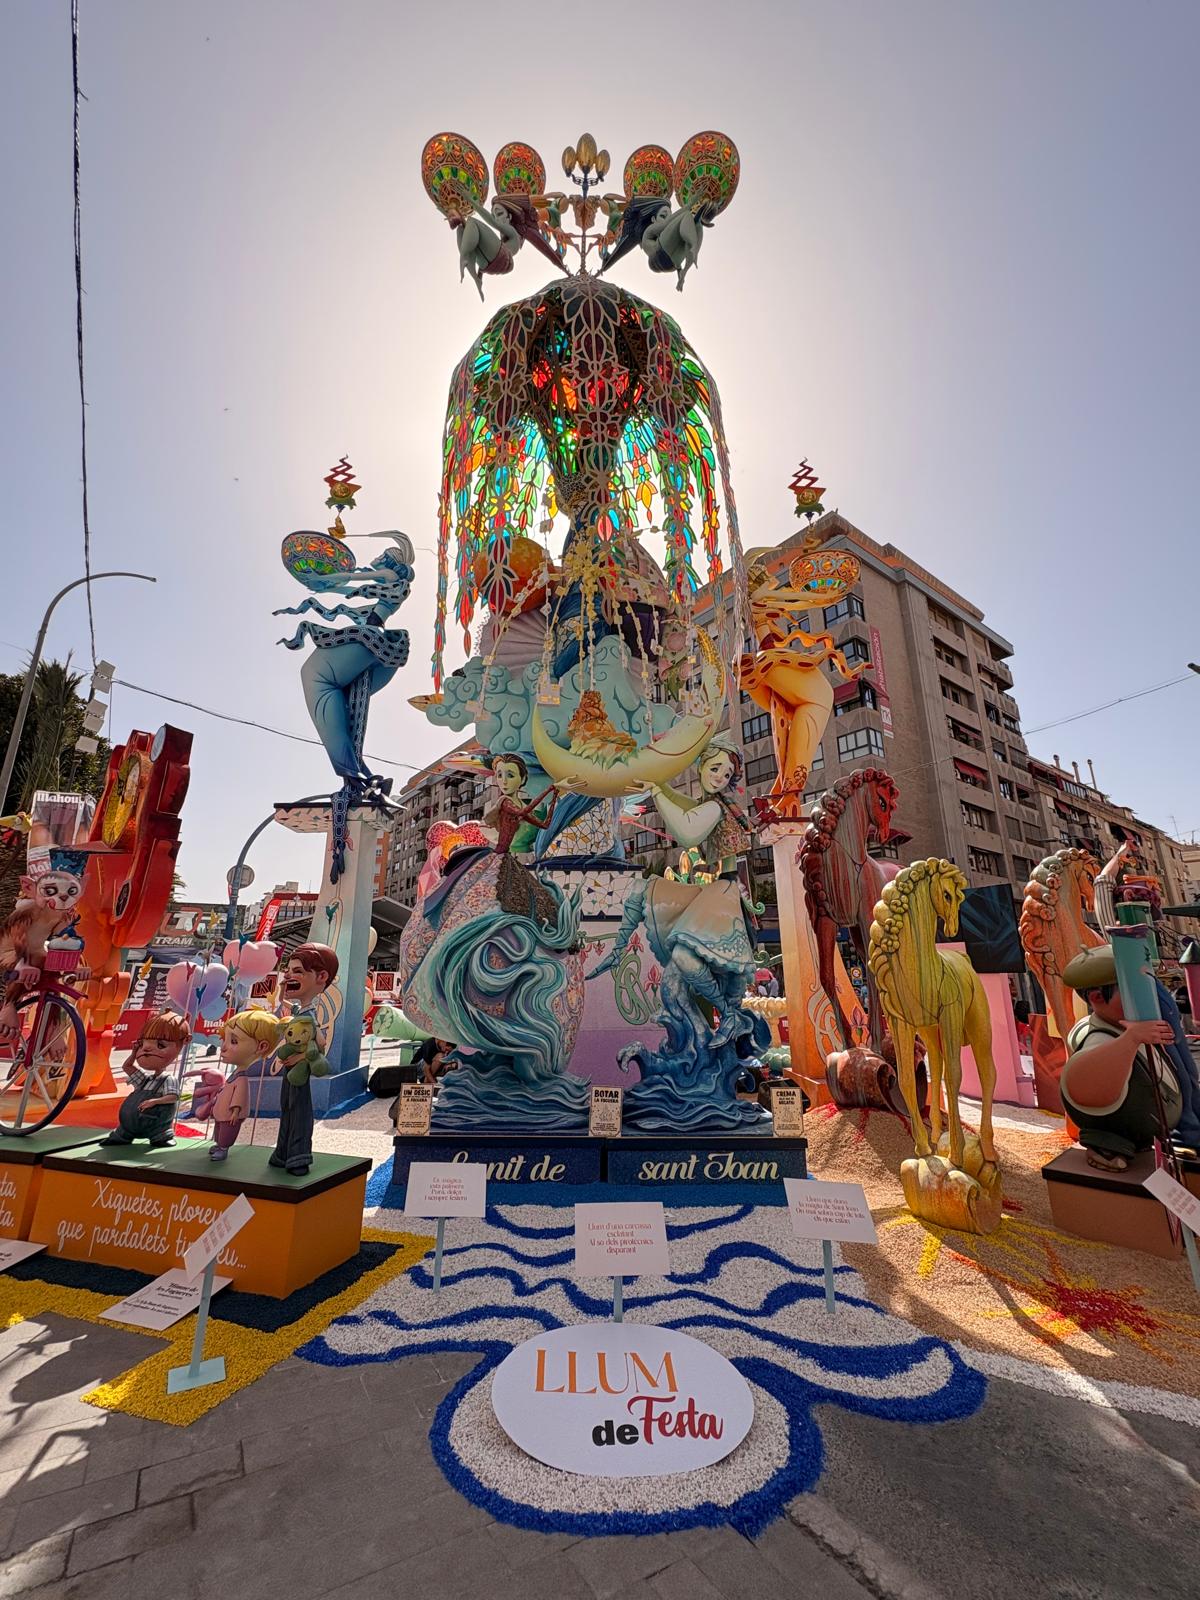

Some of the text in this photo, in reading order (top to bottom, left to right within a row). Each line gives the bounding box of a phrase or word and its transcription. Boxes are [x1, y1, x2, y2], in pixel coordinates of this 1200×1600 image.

[154, 936, 193, 945] TRAM
[594, 1089, 619, 1099] BOTAR
[530, 1154, 566, 1182] de
[638, 1151, 780, 1181] sant Joan
[92, 1179, 164, 1226] Xiquetes,
[57, 1219, 86, 1252] que
[88, 1220, 170, 1257] pardalets
[535, 1349, 679, 1394] LLUM
[592, 1395, 724, 1446] de Festa
